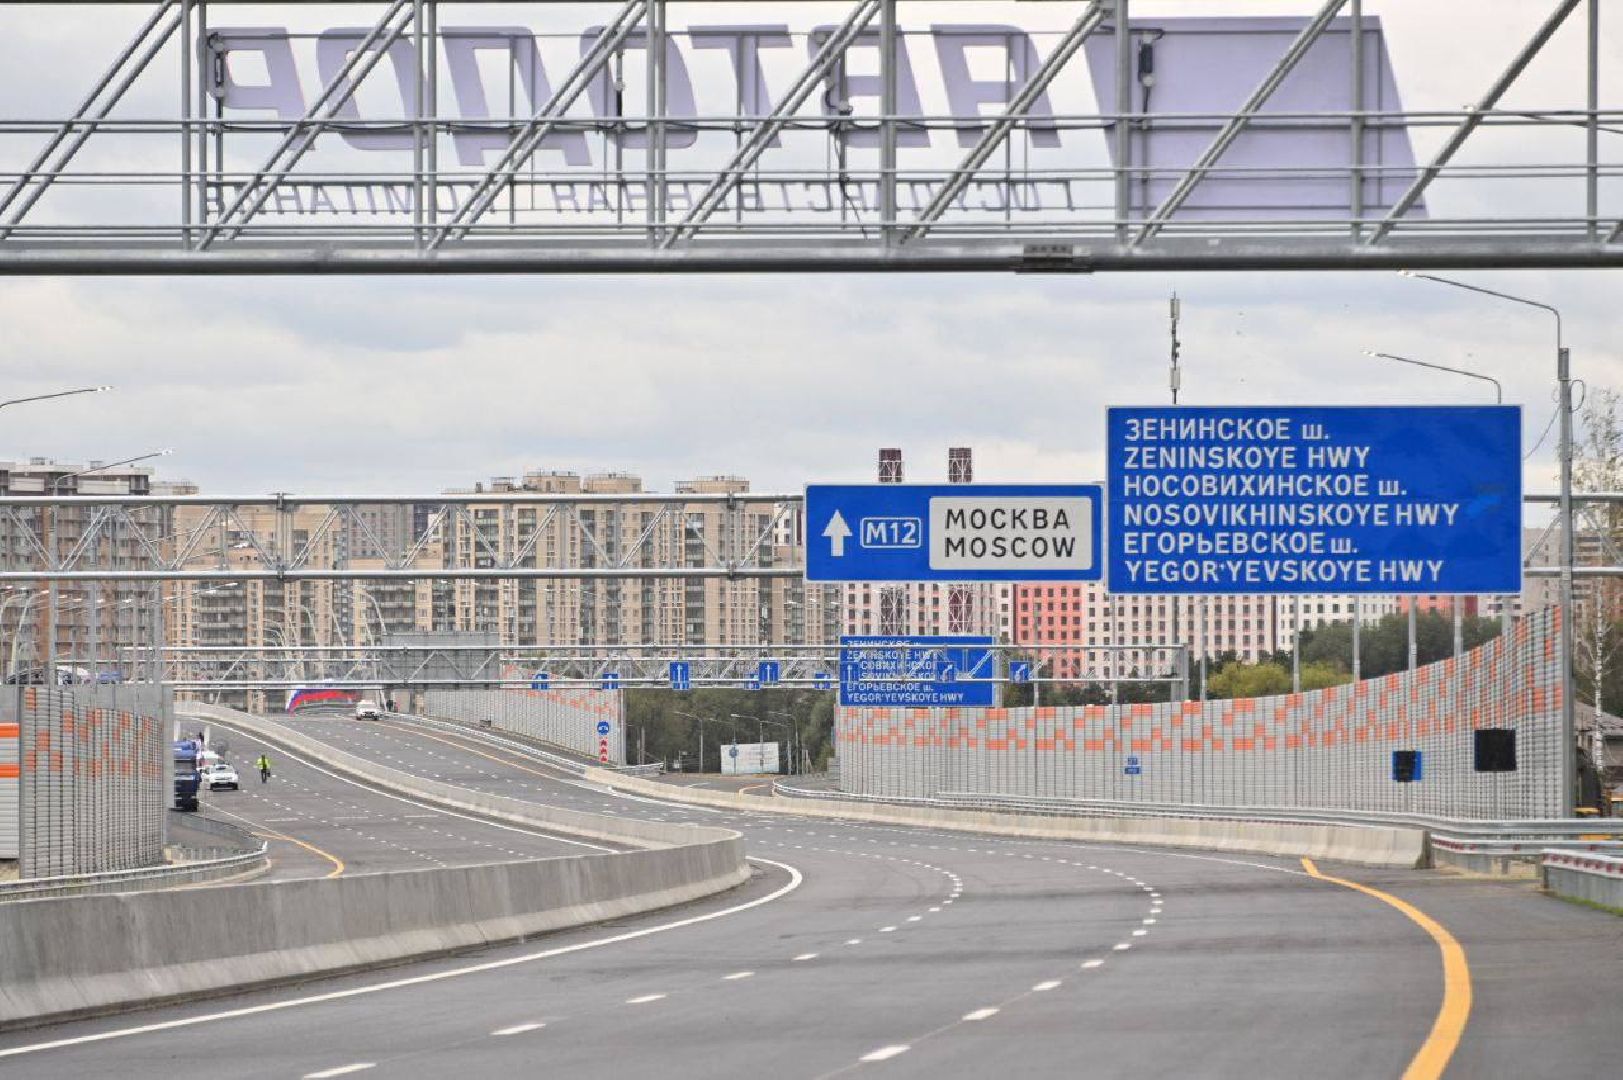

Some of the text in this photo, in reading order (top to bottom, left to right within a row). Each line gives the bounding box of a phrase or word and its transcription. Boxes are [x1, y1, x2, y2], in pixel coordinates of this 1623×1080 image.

[1124, 418, 1330, 441] ЗЕНИНСКОЕ ш.
[1124, 446, 1371, 469] ZENINSKOYE HWY
[1124, 474, 1407, 496] НОСОВИХИНСКОЕ ш.
[944, 508, 1070, 530] МОСКВА
[1124, 503, 1459, 526] NOSOVIKHINSKOYE HWY
[944, 536, 1076, 559] MOSCOW
[1124, 532, 1358, 554] ЕГОРЬЕВСКОЕ ш.
[1124, 560, 1444, 582] YEGOR'YEVSKOYE HWY
